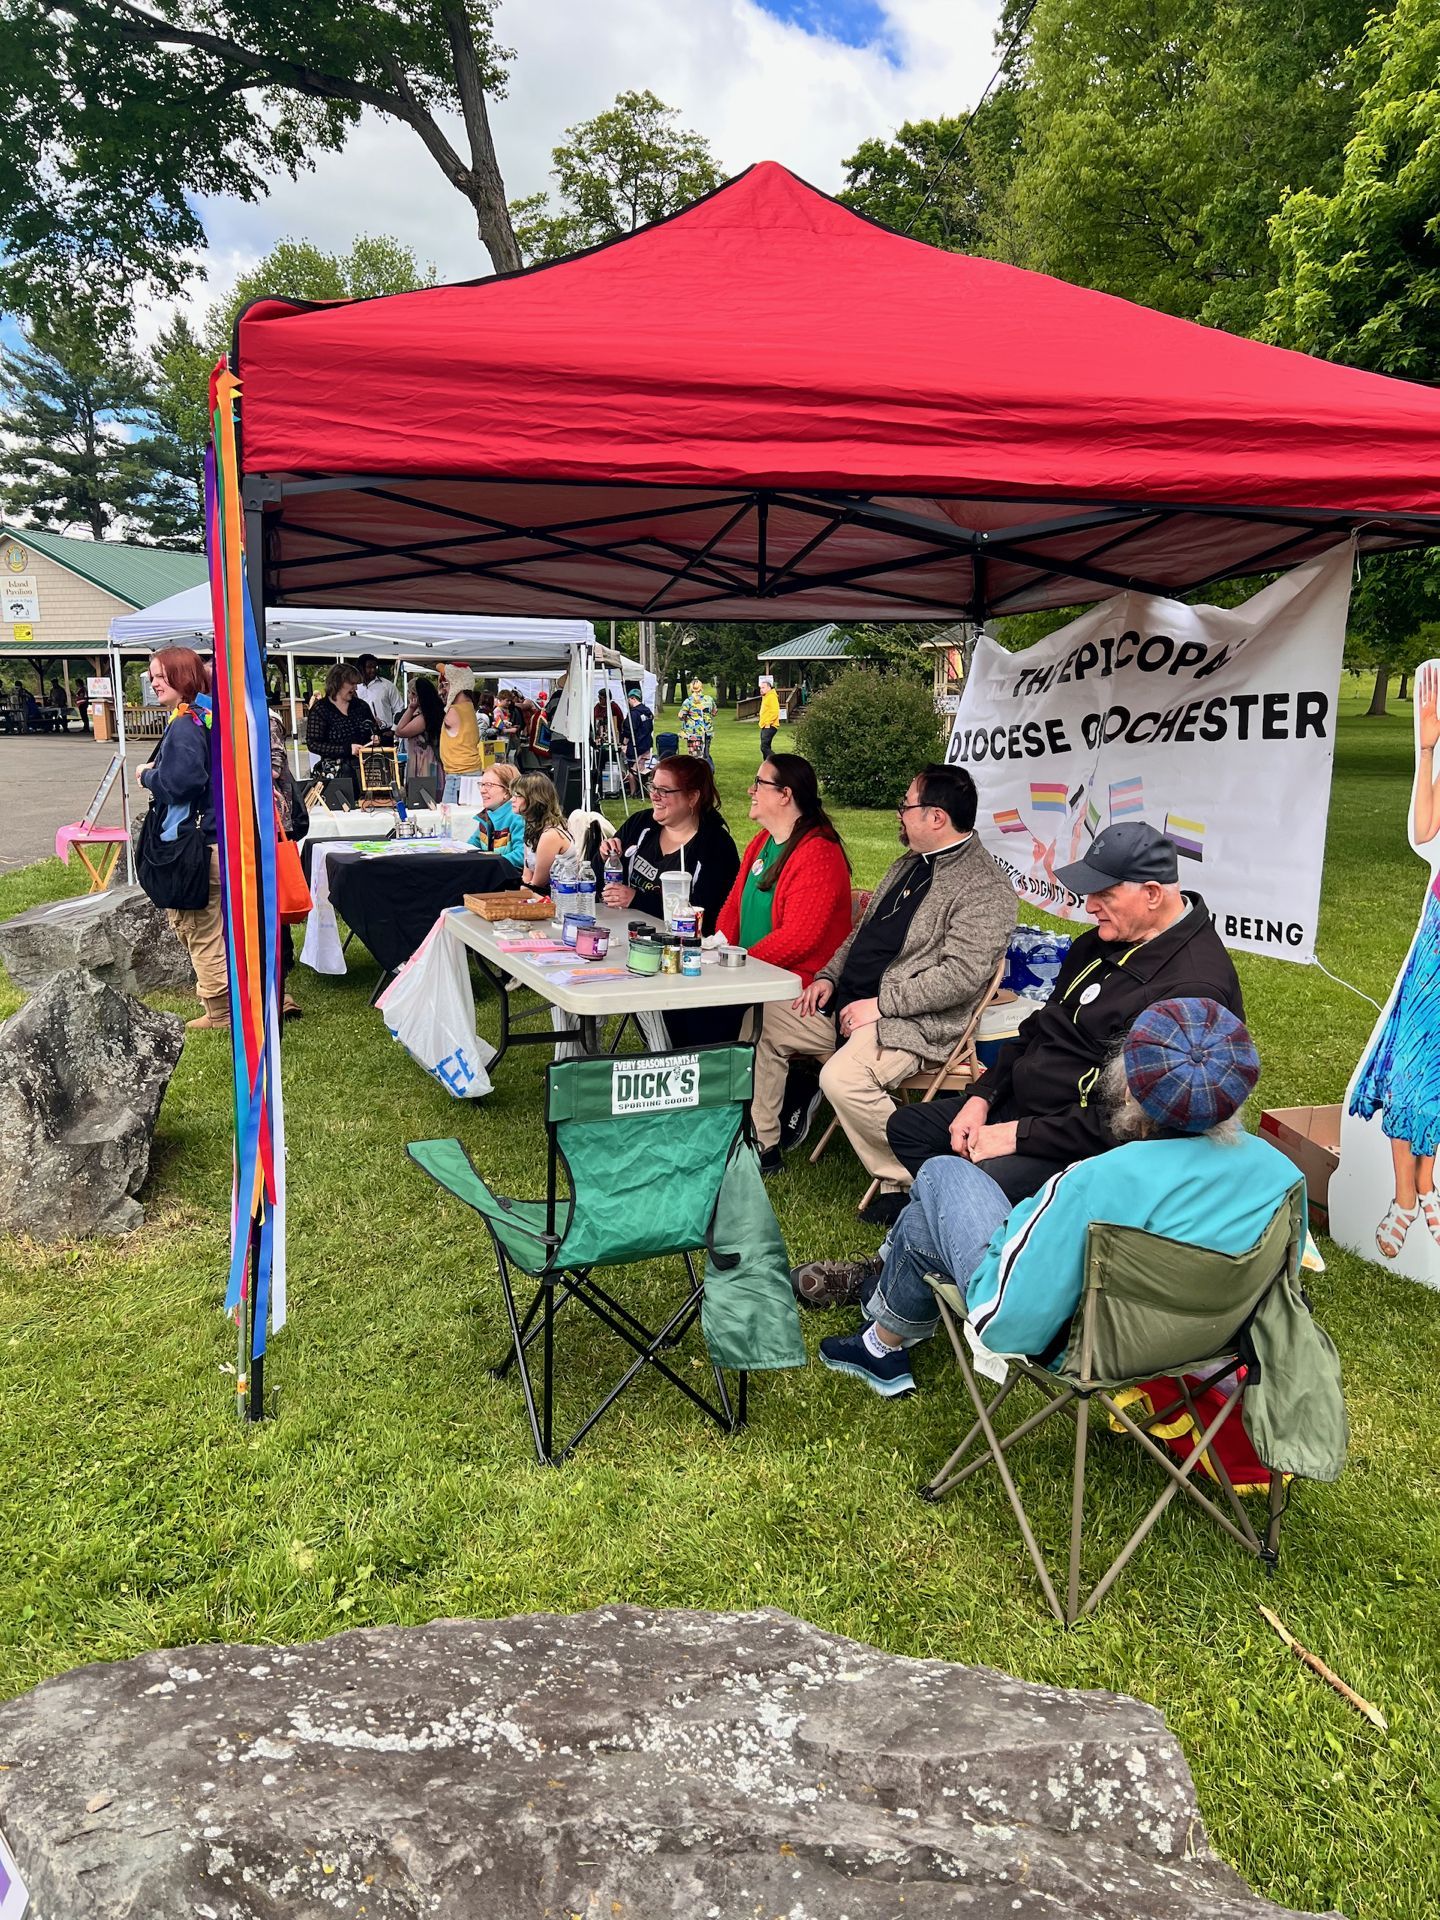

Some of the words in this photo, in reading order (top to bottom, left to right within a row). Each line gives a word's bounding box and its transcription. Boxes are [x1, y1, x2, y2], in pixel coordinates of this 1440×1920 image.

[6, 588, 33, 596] Pavilion
[8, 580, 29, 588] Island
[948, 718, 1072, 763] DIOCESE
[1102, 691, 1329, 744] OCHESTER
[634, 857, 658, 879] THIS
[1028, 876, 1065, 904] DIGNITY
[1225, 914, 1304, 946] BEING
[613, 1060, 636, 1071] EVERY
[636, 1057, 666, 1070] SEASON
[665, 1055, 690, 1067] STARTS
[690, 1054, 700, 1064] AT
[617, 1067, 696, 1102] DICK'S
[618, 1099, 662, 1110] SPORTING
[664, 1096, 694, 1105] GOODS
